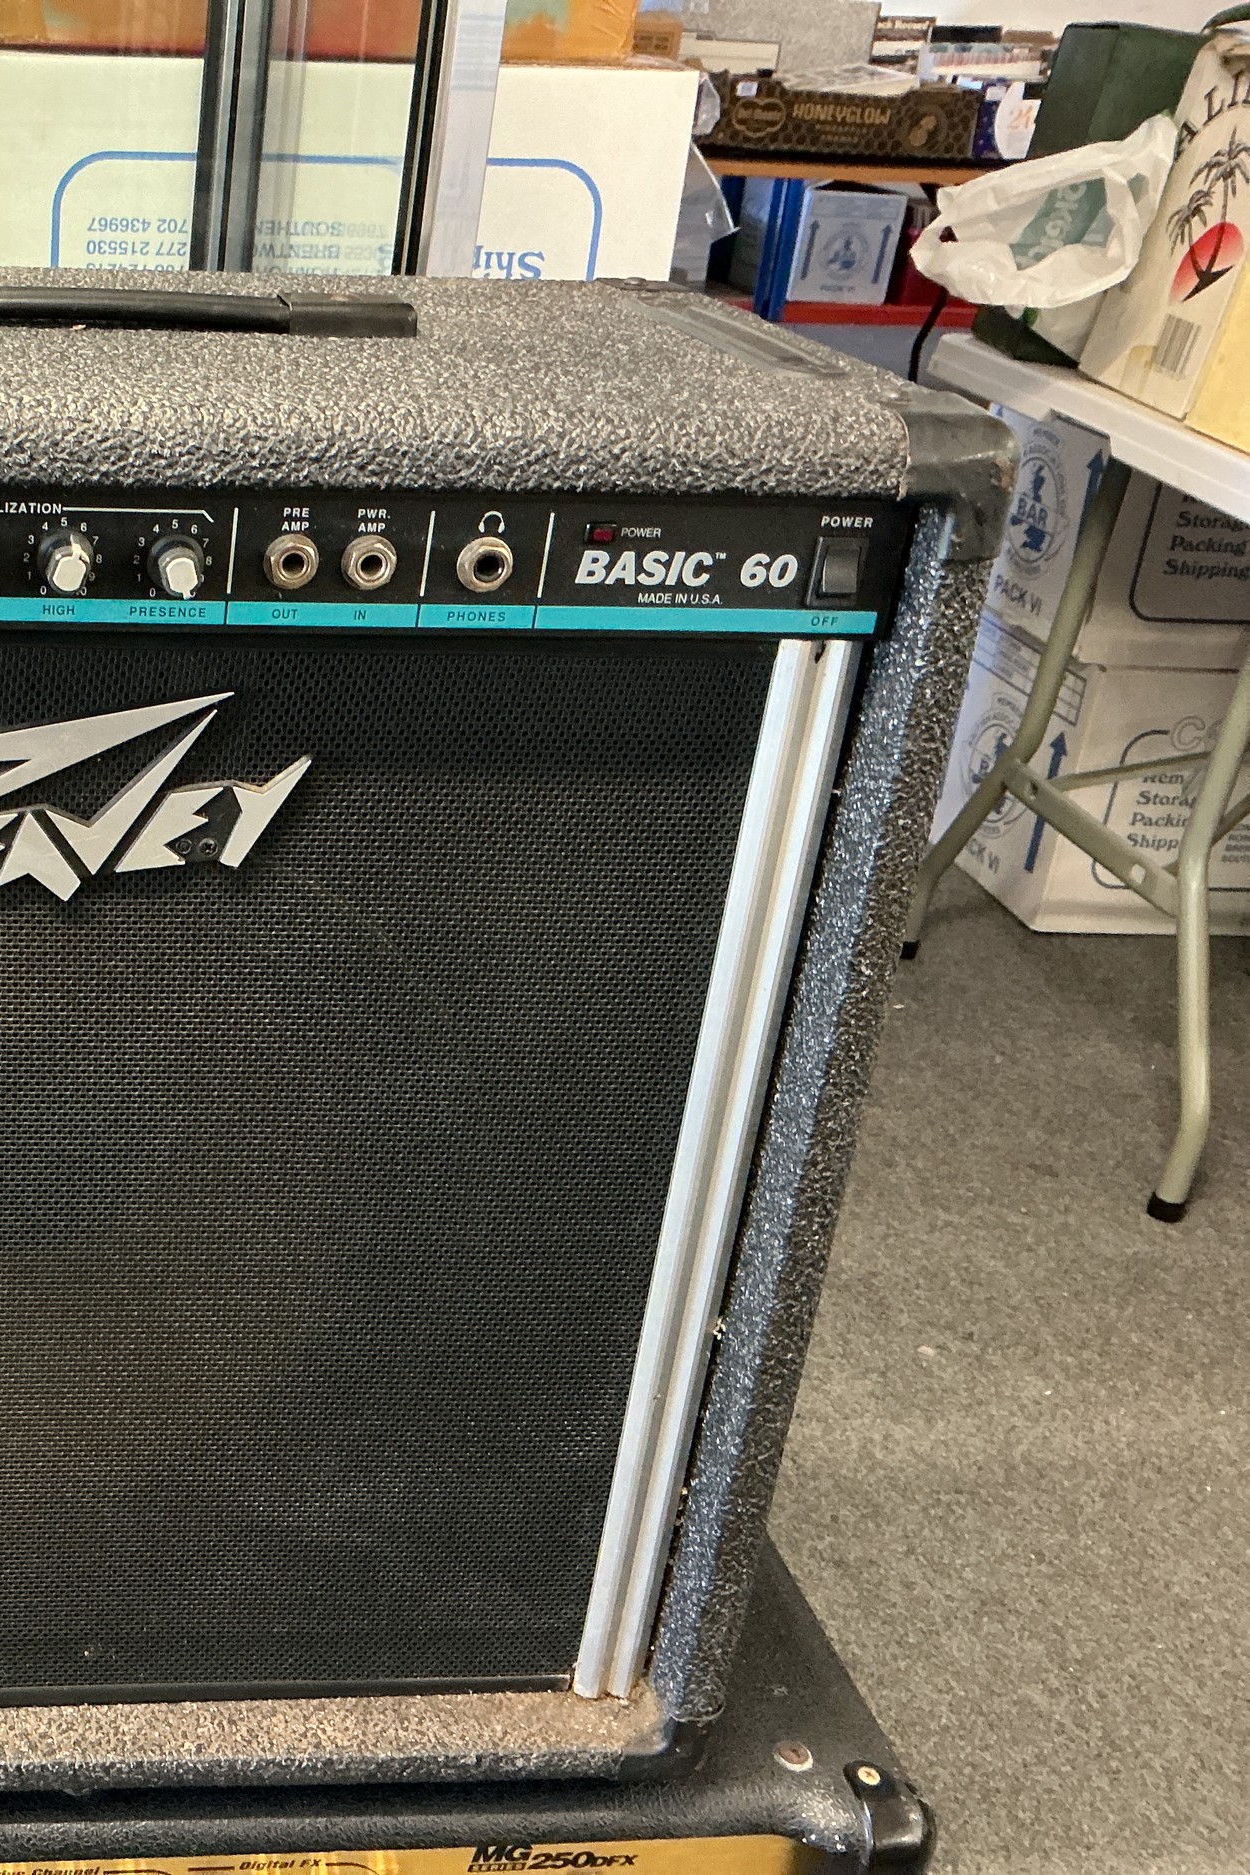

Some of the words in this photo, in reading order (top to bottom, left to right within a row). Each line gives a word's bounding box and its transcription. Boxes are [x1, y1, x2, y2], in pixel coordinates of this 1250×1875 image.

[793, 103, 891, 125] HONEYGLOW
[87, 216, 151, 233] 436967
[157, 218, 188, 234] 702
[86, 239, 150, 256] 215530
[155, 241, 188, 257] 277
[283, 508, 310, 518] PRE
[357, 508, 391, 519] PWR.
[1017, 496, 1049, 528] BAR
[41, 521, 48, 531] 4
[60, 516, 68, 527] 5
[80, 522, 87, 532] 6
[171, 518, 179, 529] 5
[282, 522, 310, 532] AMP
[821, 516, 874, 528] POWER
[152, 524, 160, 534] 4
[190, 524, 198, 534] 6
[358, 522, 386, 533] AMP
[620, 527, 662, 539] POWER
[27, 534, 35, 545] 3
[92, 535, 99, 545] 7
[137, 536, 145, 547] 3
[202, 537, 209, 548] 7
[1167, 534, 1248, 557] Packing
[23, 552, 30, 562] 2
[95, 553, 103, 564] 8
[133, 554, 140, 565] 2
[205, 555, 213, 566] 8
[27, 571, 32, 580] 1
[740, 553, 798, 588] 60
[89, 572, 96, 581] 9
[137, 574, 141, 582] 1
[40, 585, 47, 595] 0
[149, 587, 156, 598] 0
[994, 573, 1029, 608] PACK
[637, 592, 672, 604] MADE
[674, 594, 688, 605] IN
[690, 594, 723, 606] U.S.A.
[42, 605, 76, 616] HIGH
[129, 606, 206, 618] PRESENCE
[271, 608, 298, 620] OUT
[353, 609, 366, 620] IN
[447, 611, 506, 622] PHONES
[810, 615, 839, 627] OFF
[472, 1841, 533, 1863] MG
[239, 1859, 295, 1871] Digital
[299, 1858, 322, 1868] FX
